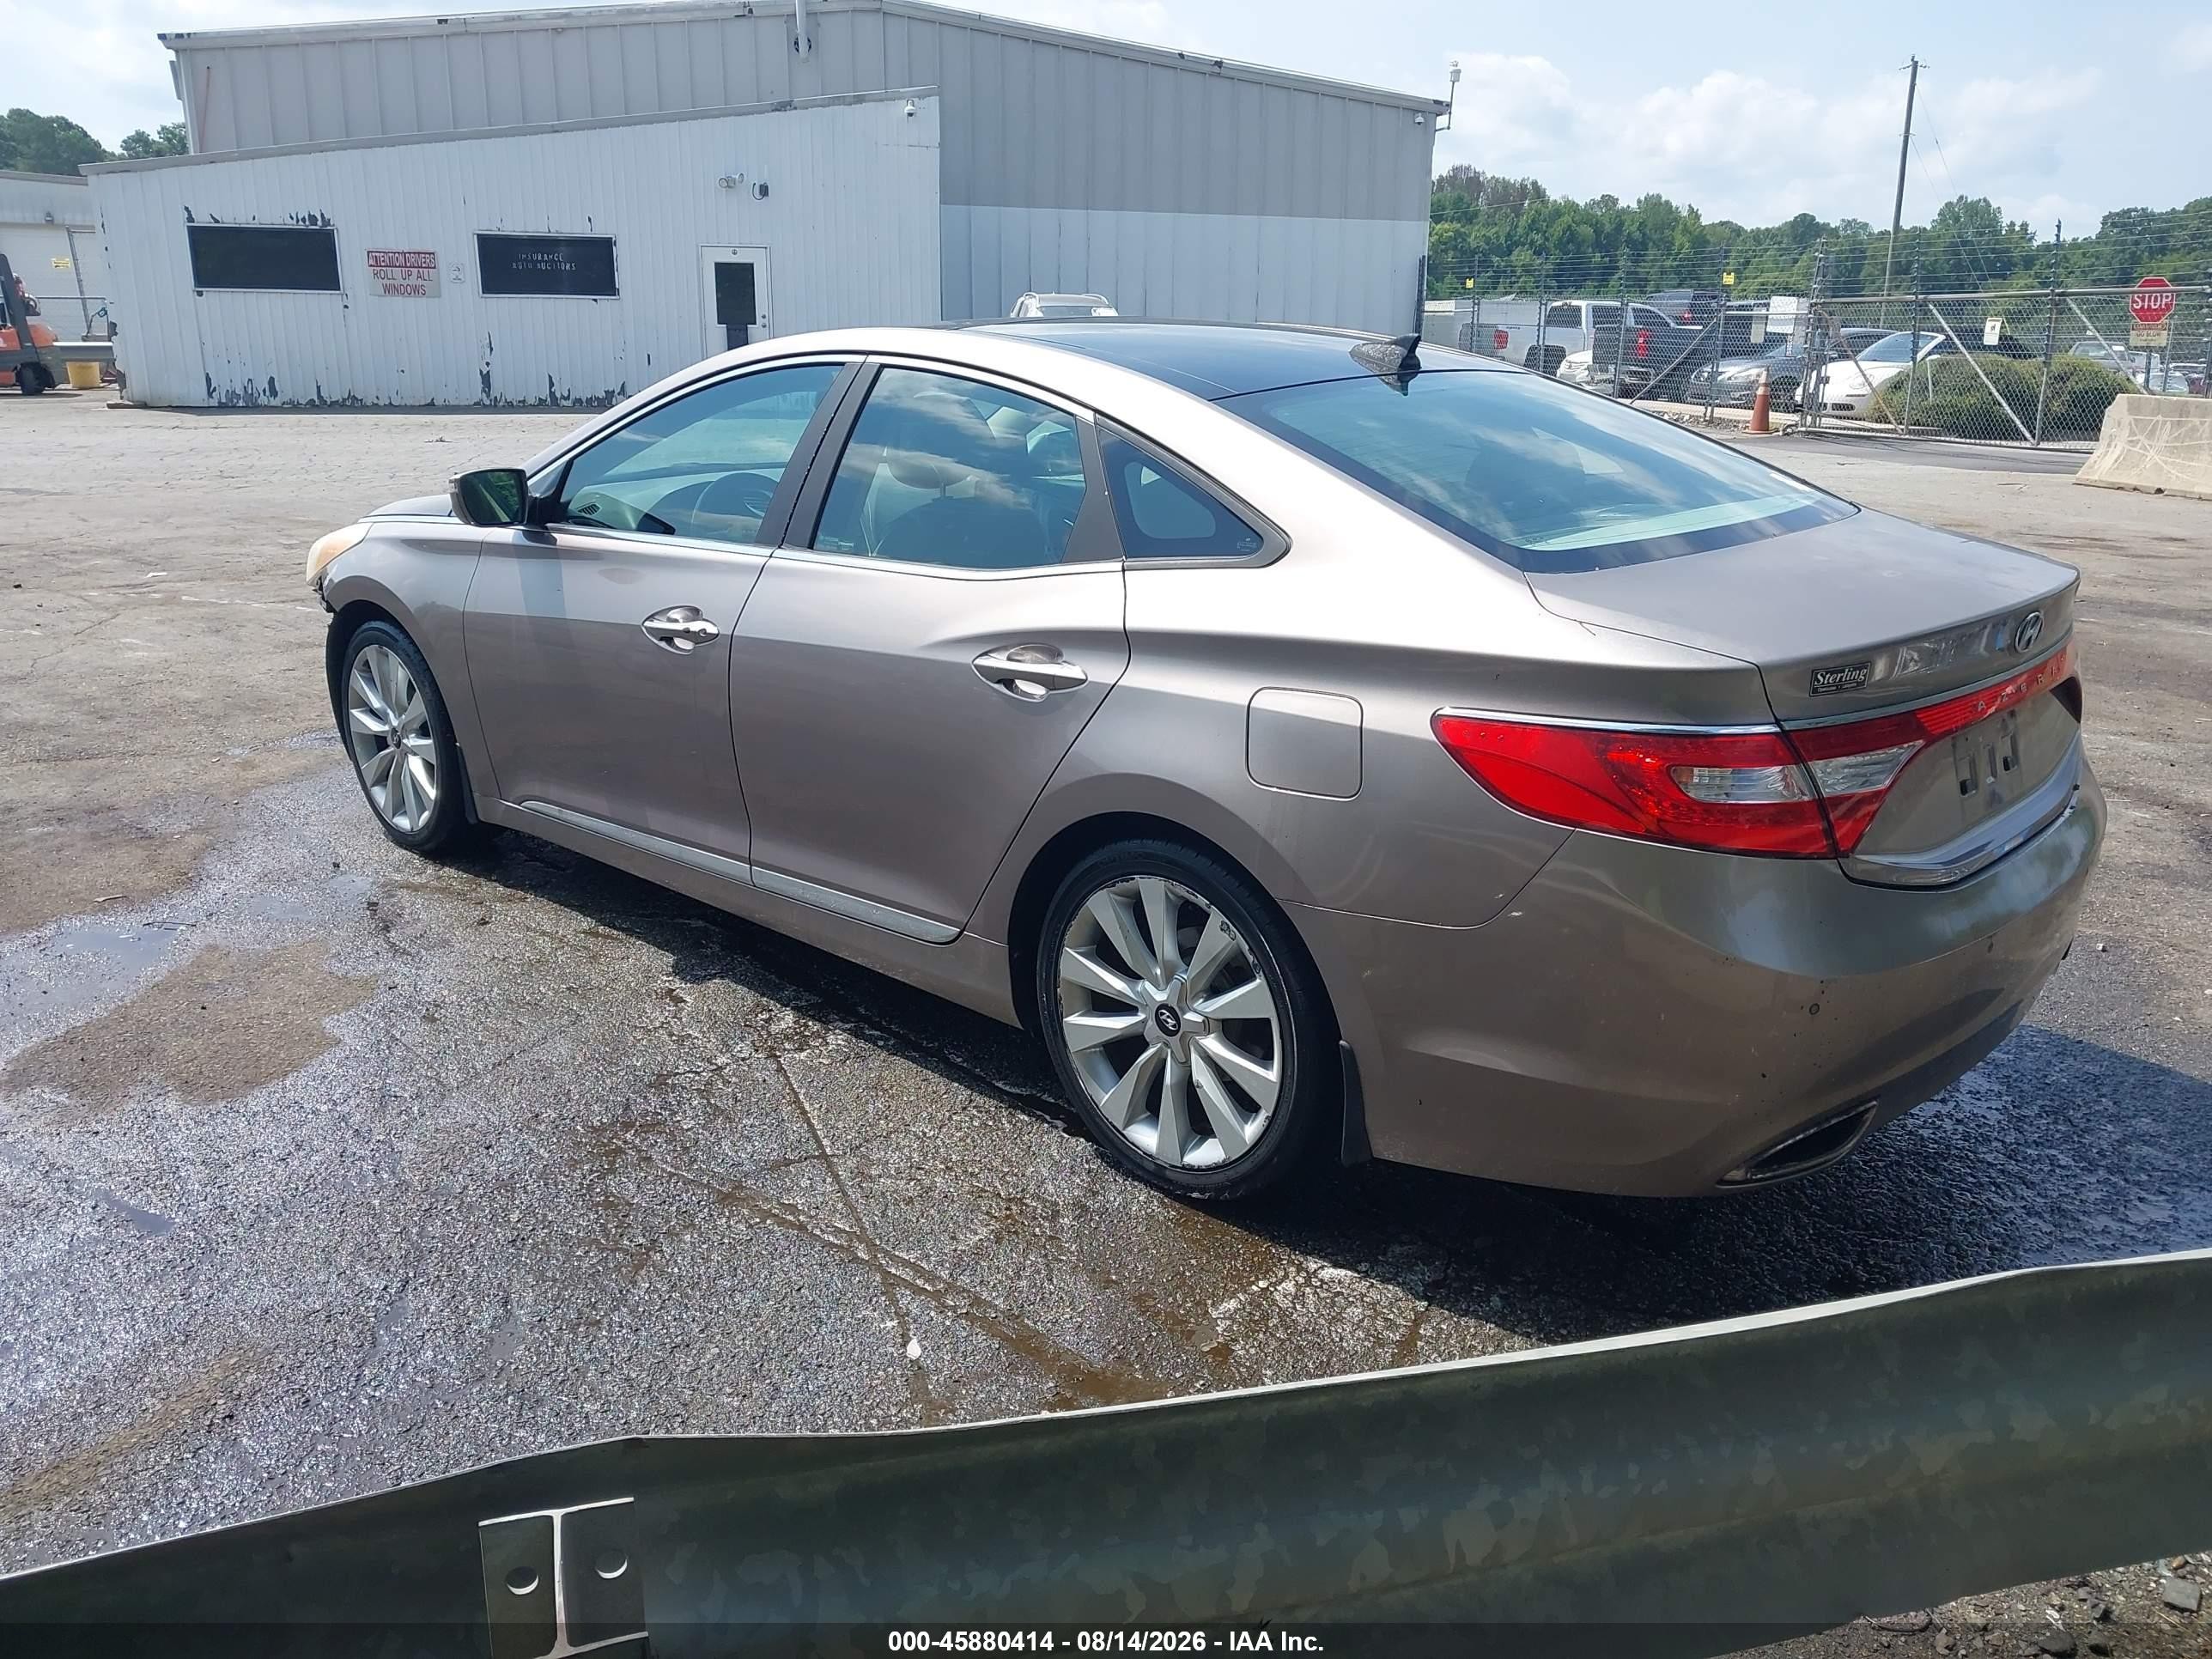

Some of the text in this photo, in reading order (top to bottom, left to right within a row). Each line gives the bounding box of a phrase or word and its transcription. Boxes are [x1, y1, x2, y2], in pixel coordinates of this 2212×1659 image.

[368, 252, 435, 269] ATTENTION DRIVERS
[373, 269, 434, 282] ROLL UP ALL
[382, 283, 427, 296] WINDOWS
[2133, 293, 2172, 309] STOP
[1814, 668, 1868, 685] Sterling
